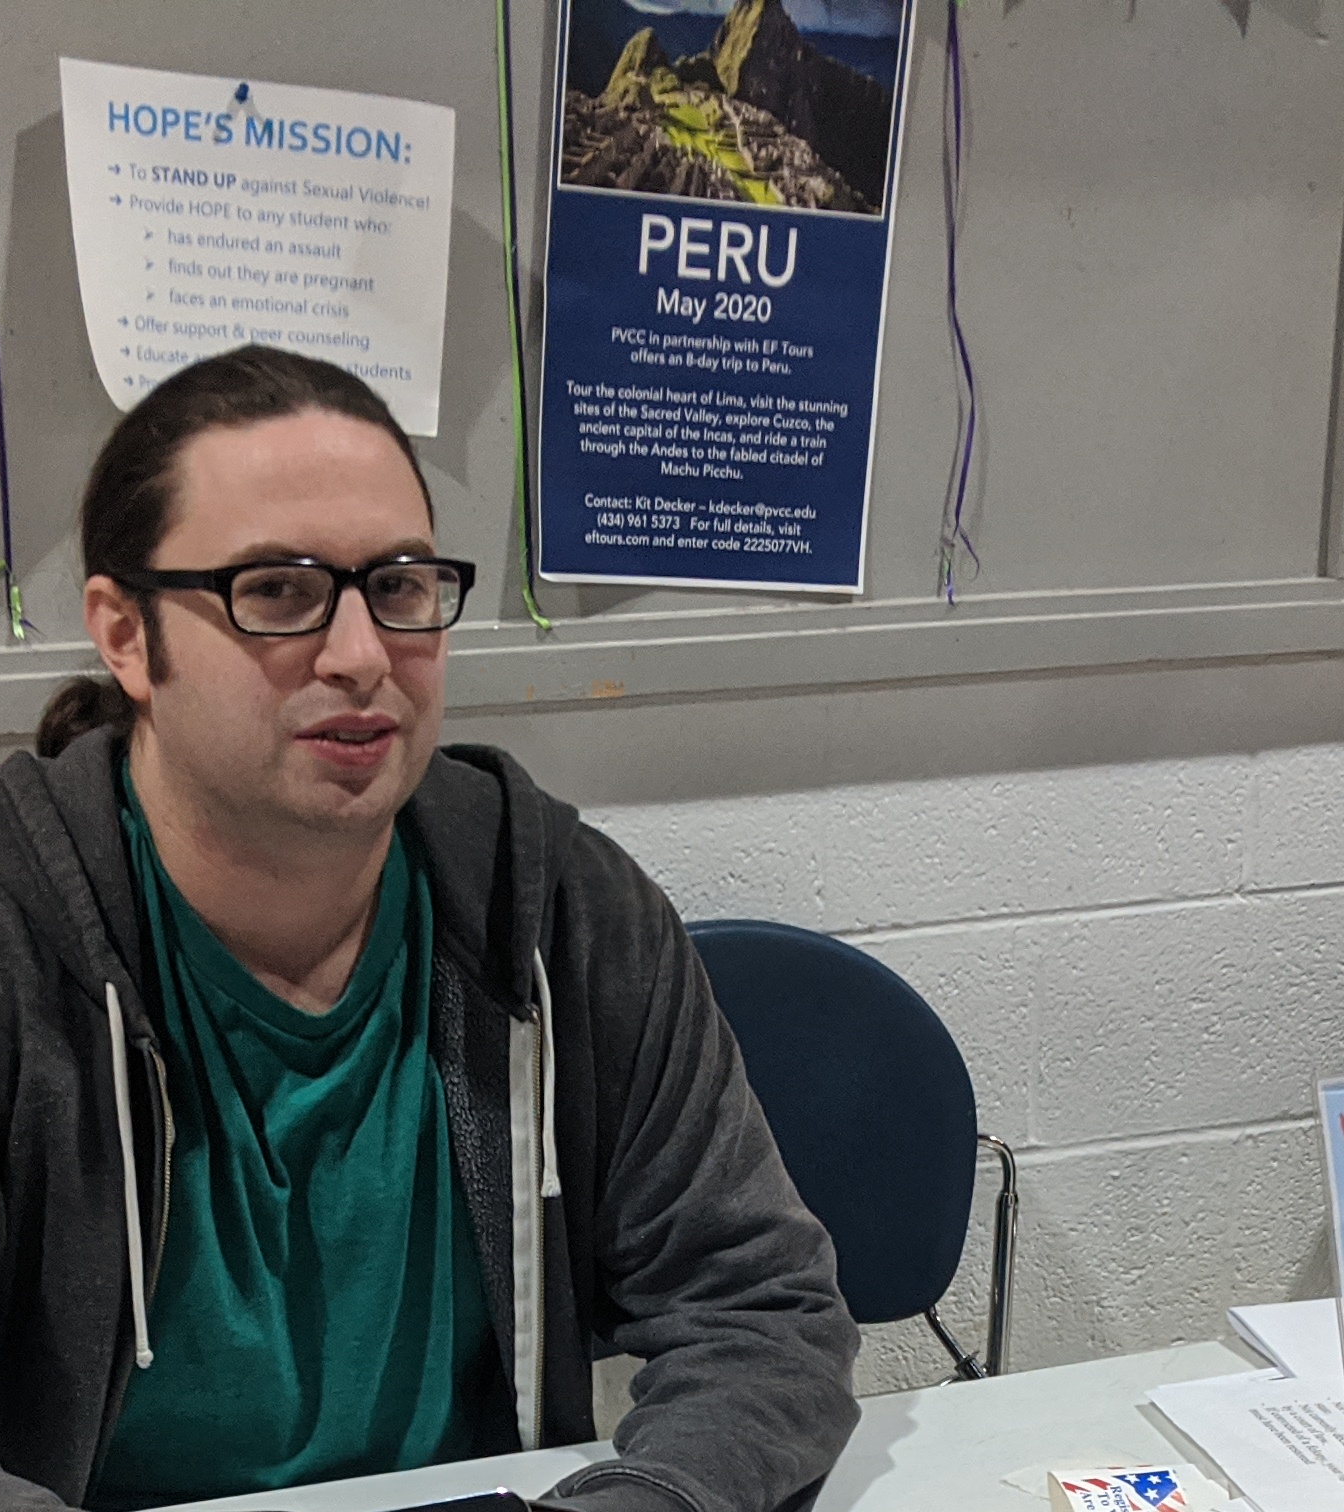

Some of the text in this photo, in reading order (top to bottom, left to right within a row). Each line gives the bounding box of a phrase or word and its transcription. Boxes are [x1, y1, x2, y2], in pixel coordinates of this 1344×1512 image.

[109, 103, 410, 162] HOPE'S MISSION:
[639, 214, 796, 286] PERU
[166, 258, 373, 293] finds out they are pregnant
[657, 287, 770, 322] May 2020
[612, 327, 812, 357] PVCC in partnership with EF Tours
[661, 461, 742, 478] Machu Picchu.
[585, 493, 815, 520] Contact: Kit Decker kdecker@pvcc.edu
[1080, 1492, 1096, 1512] Are
[1098, 1492, 1109, 1507] To
